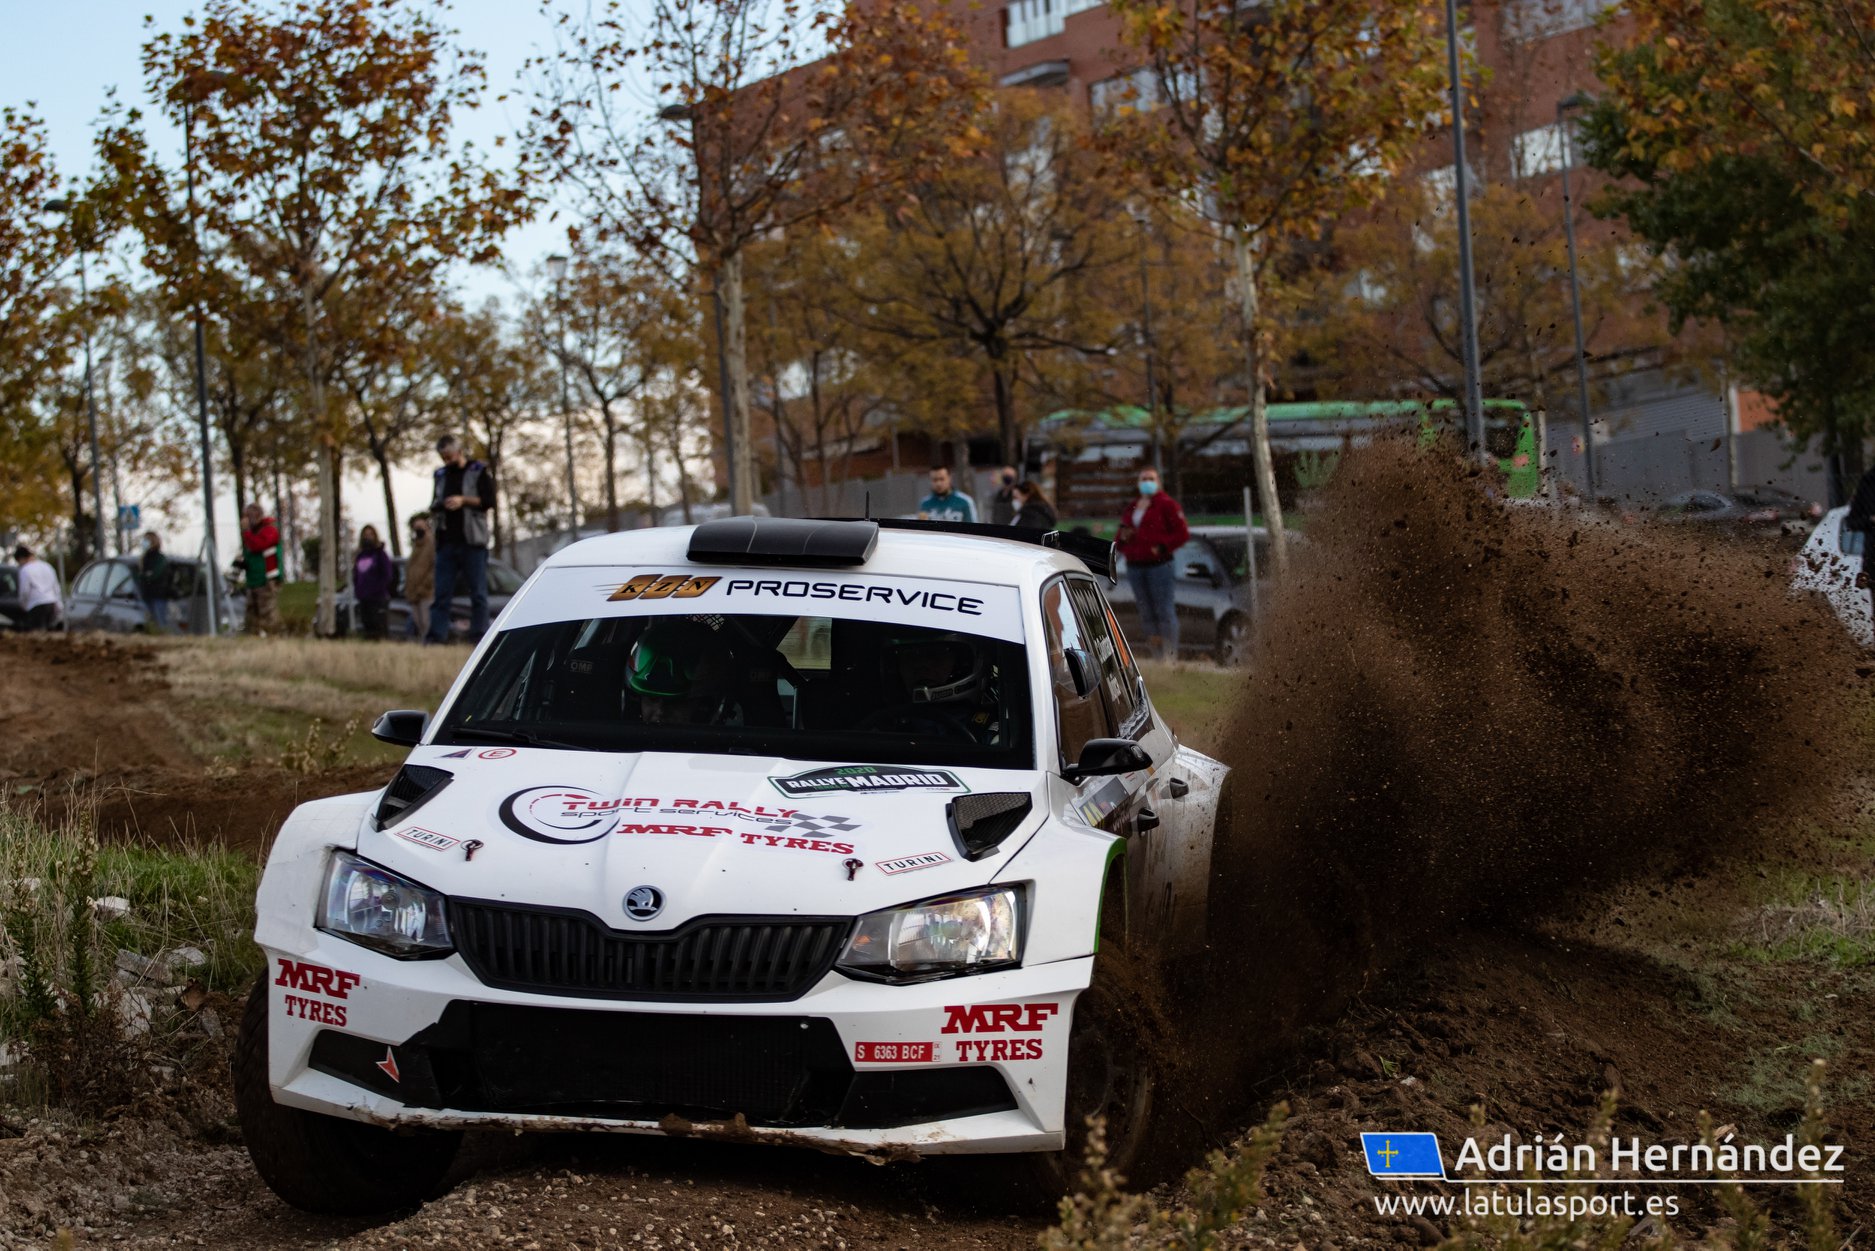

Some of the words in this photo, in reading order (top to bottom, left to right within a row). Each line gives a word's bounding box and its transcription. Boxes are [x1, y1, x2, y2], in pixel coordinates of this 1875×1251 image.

[726, 580, 985, 616] PROSERVICE
[786, 777, 849, 788] RALLYE
[845, 774, 949, 788] MADRID
[673, 798, 800, 818] RALLY
[405, 829, 453, 848] TURINI
[616, 824, 733, 837] MRF
[740, 832, 855, 855] TYRES
[883, 854, 944, 871] TURINI
[275, 958, 361, 999] MRF
[284, 993, 348, 1028] TYRES
[941, 1002, 1059, 1035] MRF
[857, 1044, 866, 1060] S
[873, 1044, 898, 1060] 6363
[901, 1044, 925, 1060] BCF
[956, 1038, 1043, 1062] TYRES
